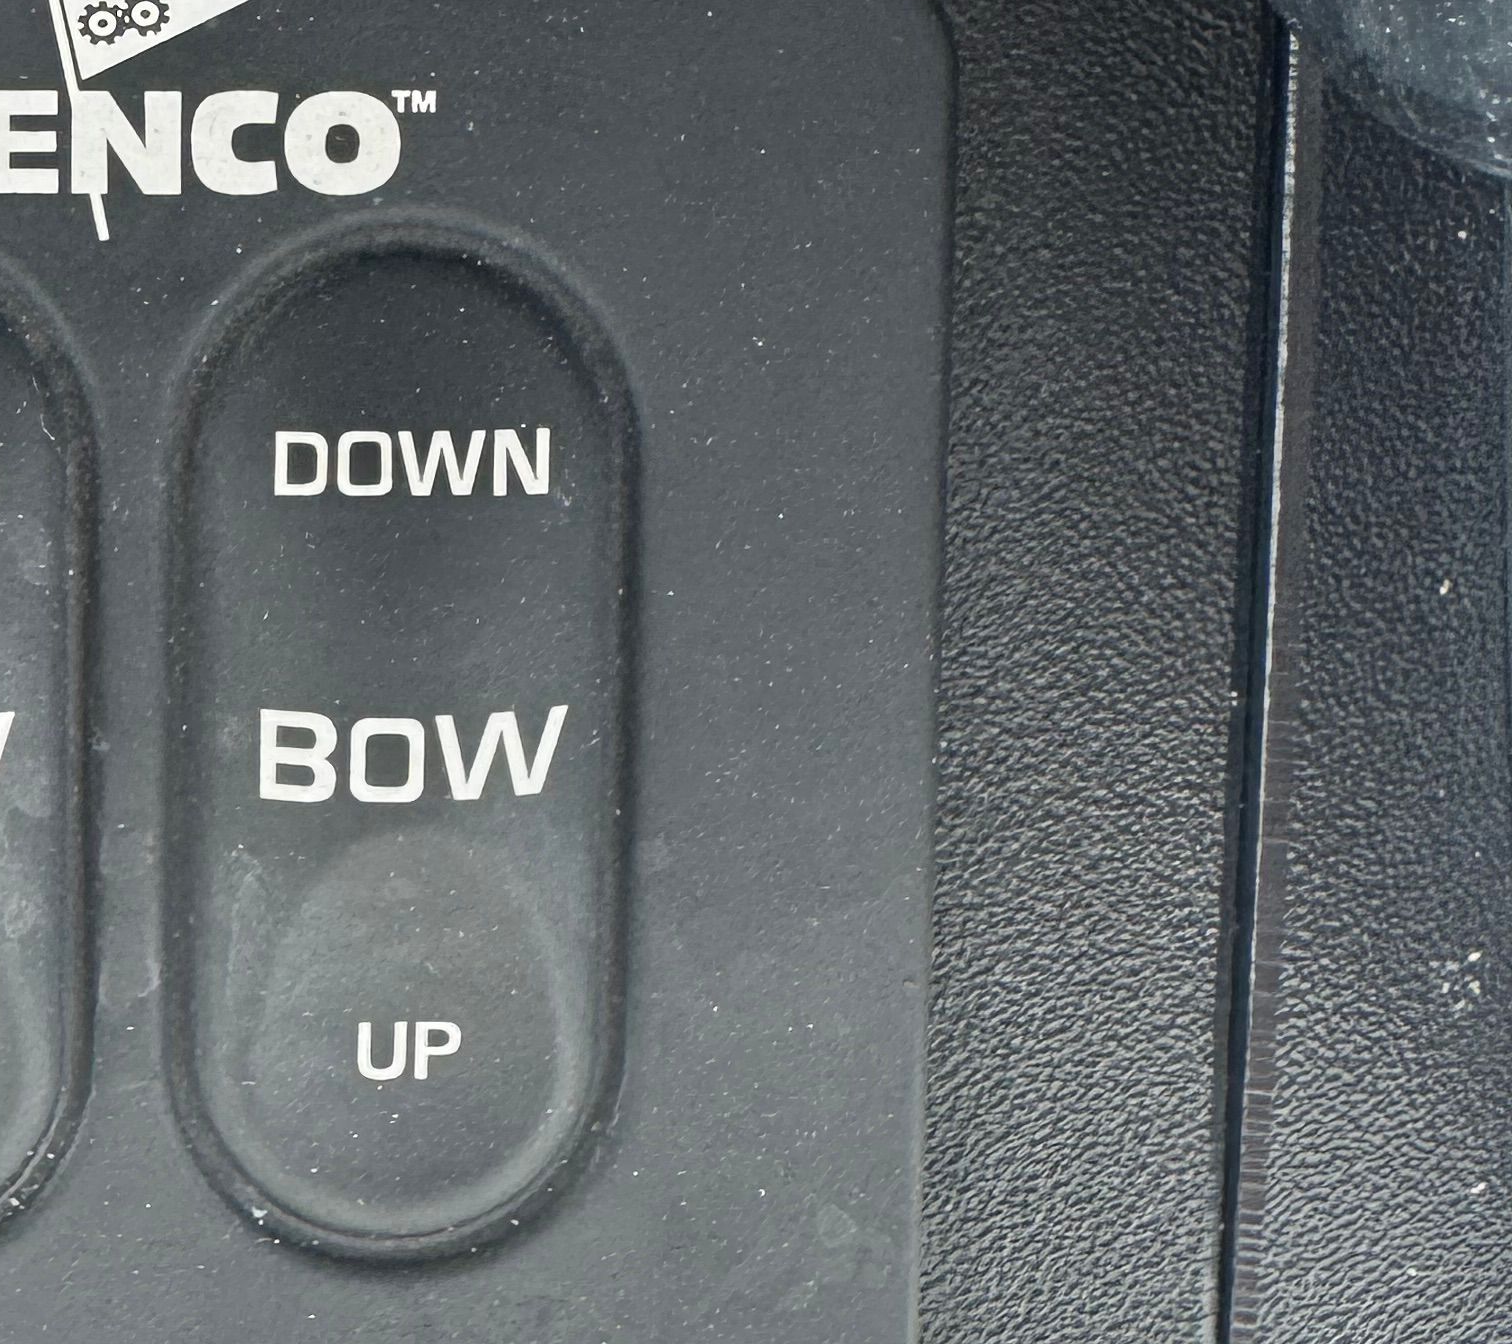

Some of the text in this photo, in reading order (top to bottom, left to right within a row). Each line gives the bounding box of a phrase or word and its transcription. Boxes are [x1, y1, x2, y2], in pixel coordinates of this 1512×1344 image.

[273, 428, 552, 497] DOWN
[258, 704, 569, 804] BOW
[355, 1019, 463, 1082] UP
